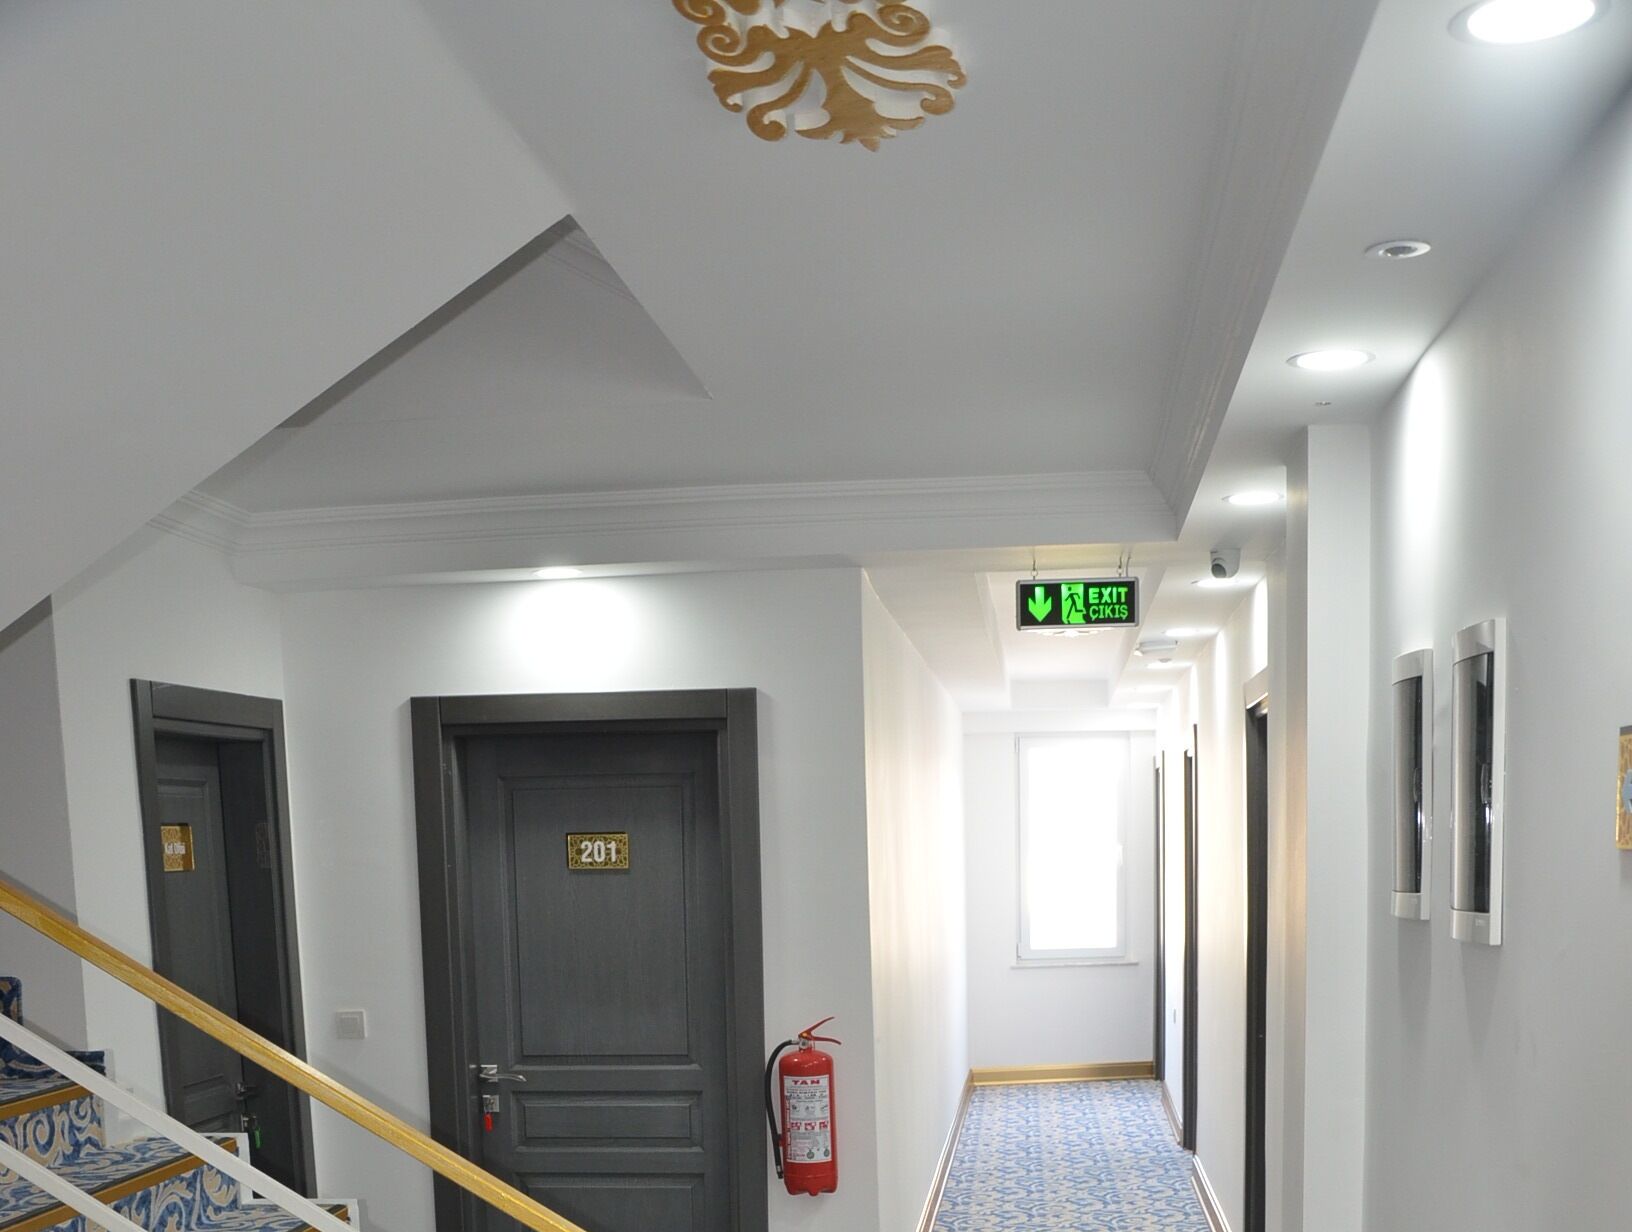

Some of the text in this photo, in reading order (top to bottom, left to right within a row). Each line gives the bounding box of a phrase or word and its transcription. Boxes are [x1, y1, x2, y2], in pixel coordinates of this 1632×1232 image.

[1088, 587, 1128, 604] EXIT
[1089, 604, 1128, 621] ÇIKIŞ
[580, 840, 617, 863] 201
